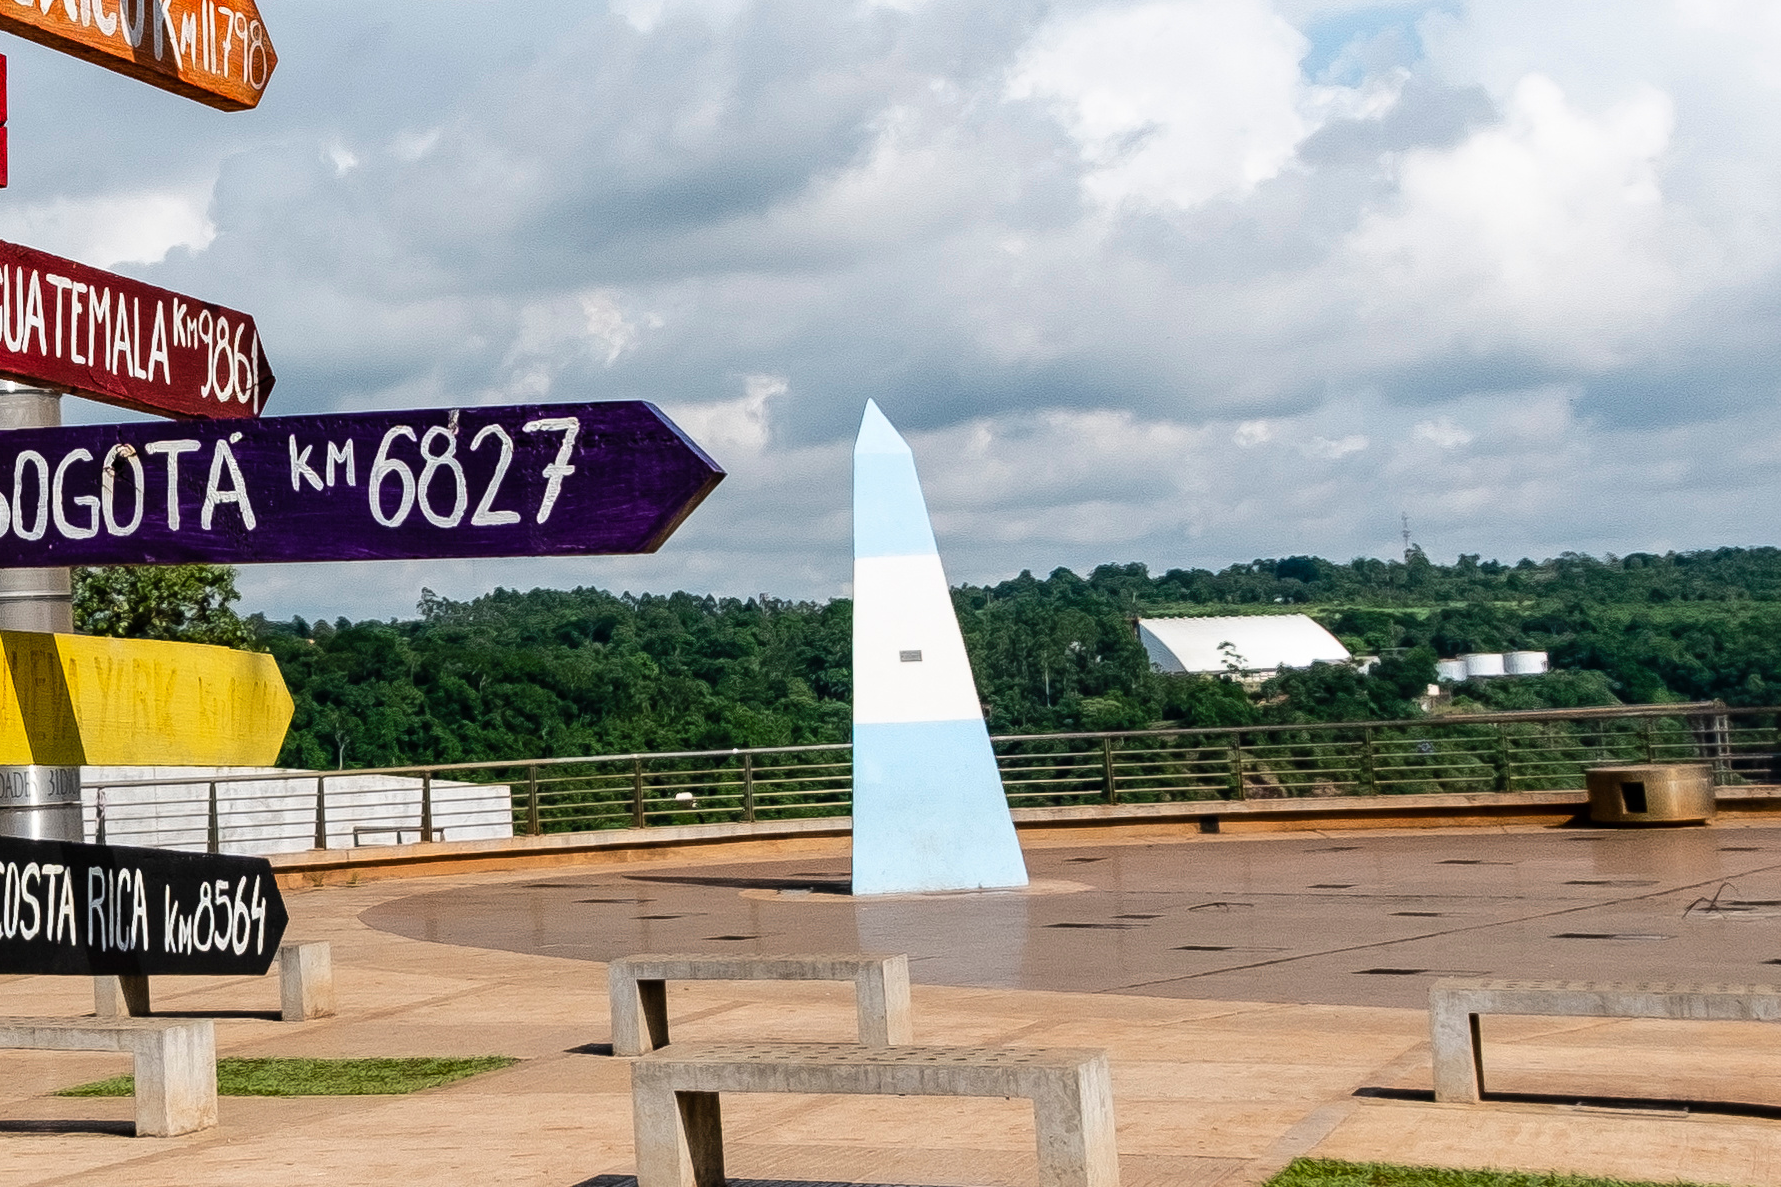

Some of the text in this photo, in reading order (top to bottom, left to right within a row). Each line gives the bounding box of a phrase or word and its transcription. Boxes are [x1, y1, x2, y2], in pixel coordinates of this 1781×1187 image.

[199, 309, 261, 415] 9861
[368, 415, 581, 529] 6827
[87, 865, 150, 953] RICA
[193, 874, 268, 956] 8564
